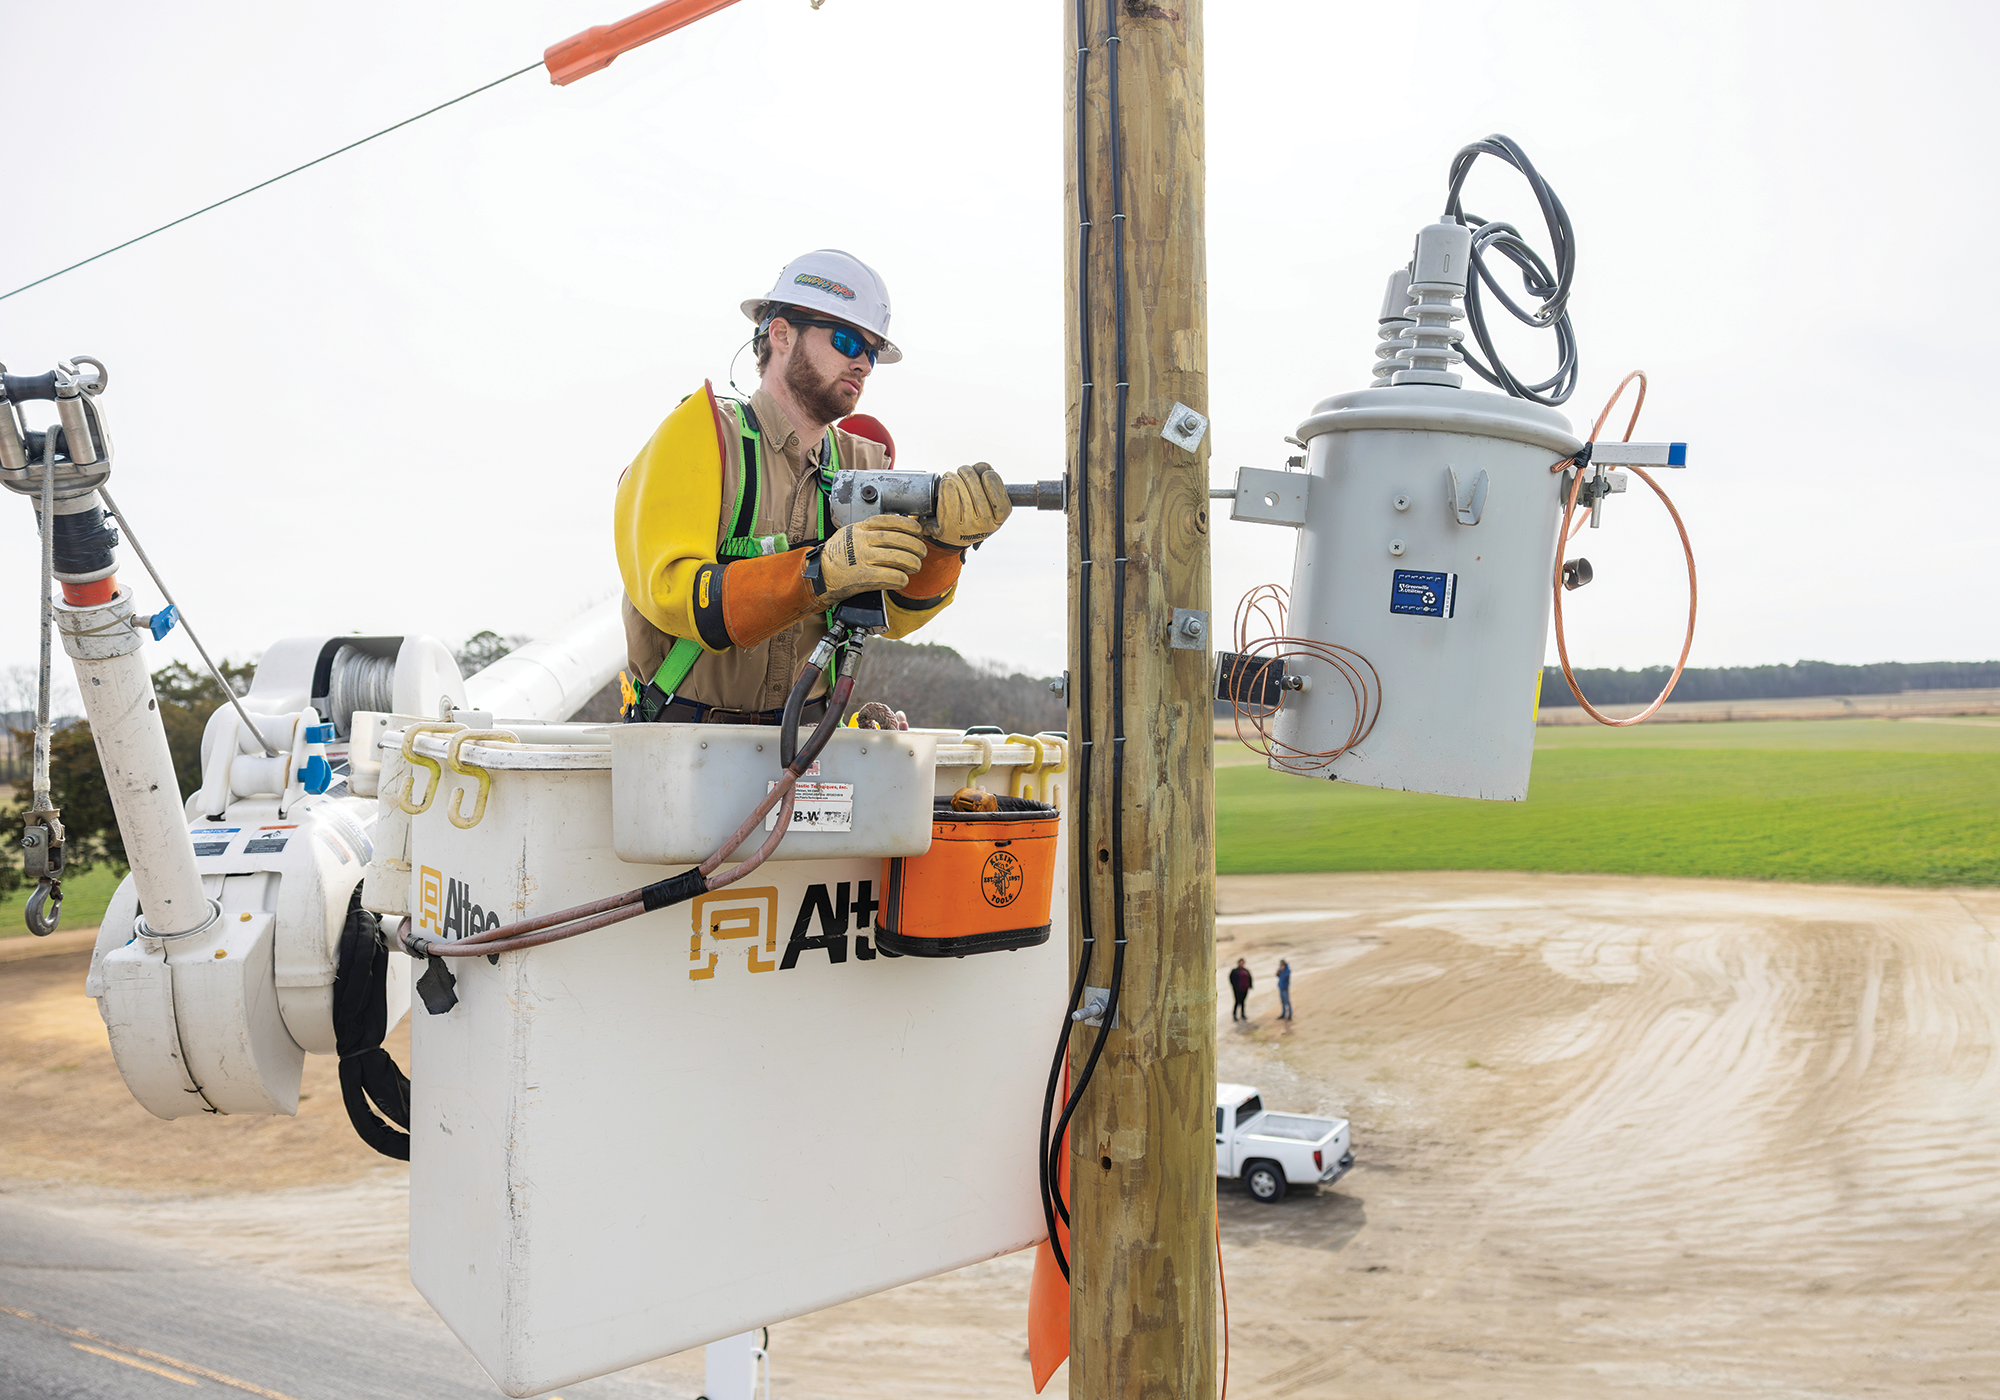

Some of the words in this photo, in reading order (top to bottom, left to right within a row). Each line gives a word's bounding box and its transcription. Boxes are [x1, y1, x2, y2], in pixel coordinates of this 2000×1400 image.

[796, 274, 855, 299] CONDUCTORS
[990, 854, 1013, 865] KLEIN
[991, 893, 1013, 904] TOOLS
[779, 880, 879, 970] Alt
